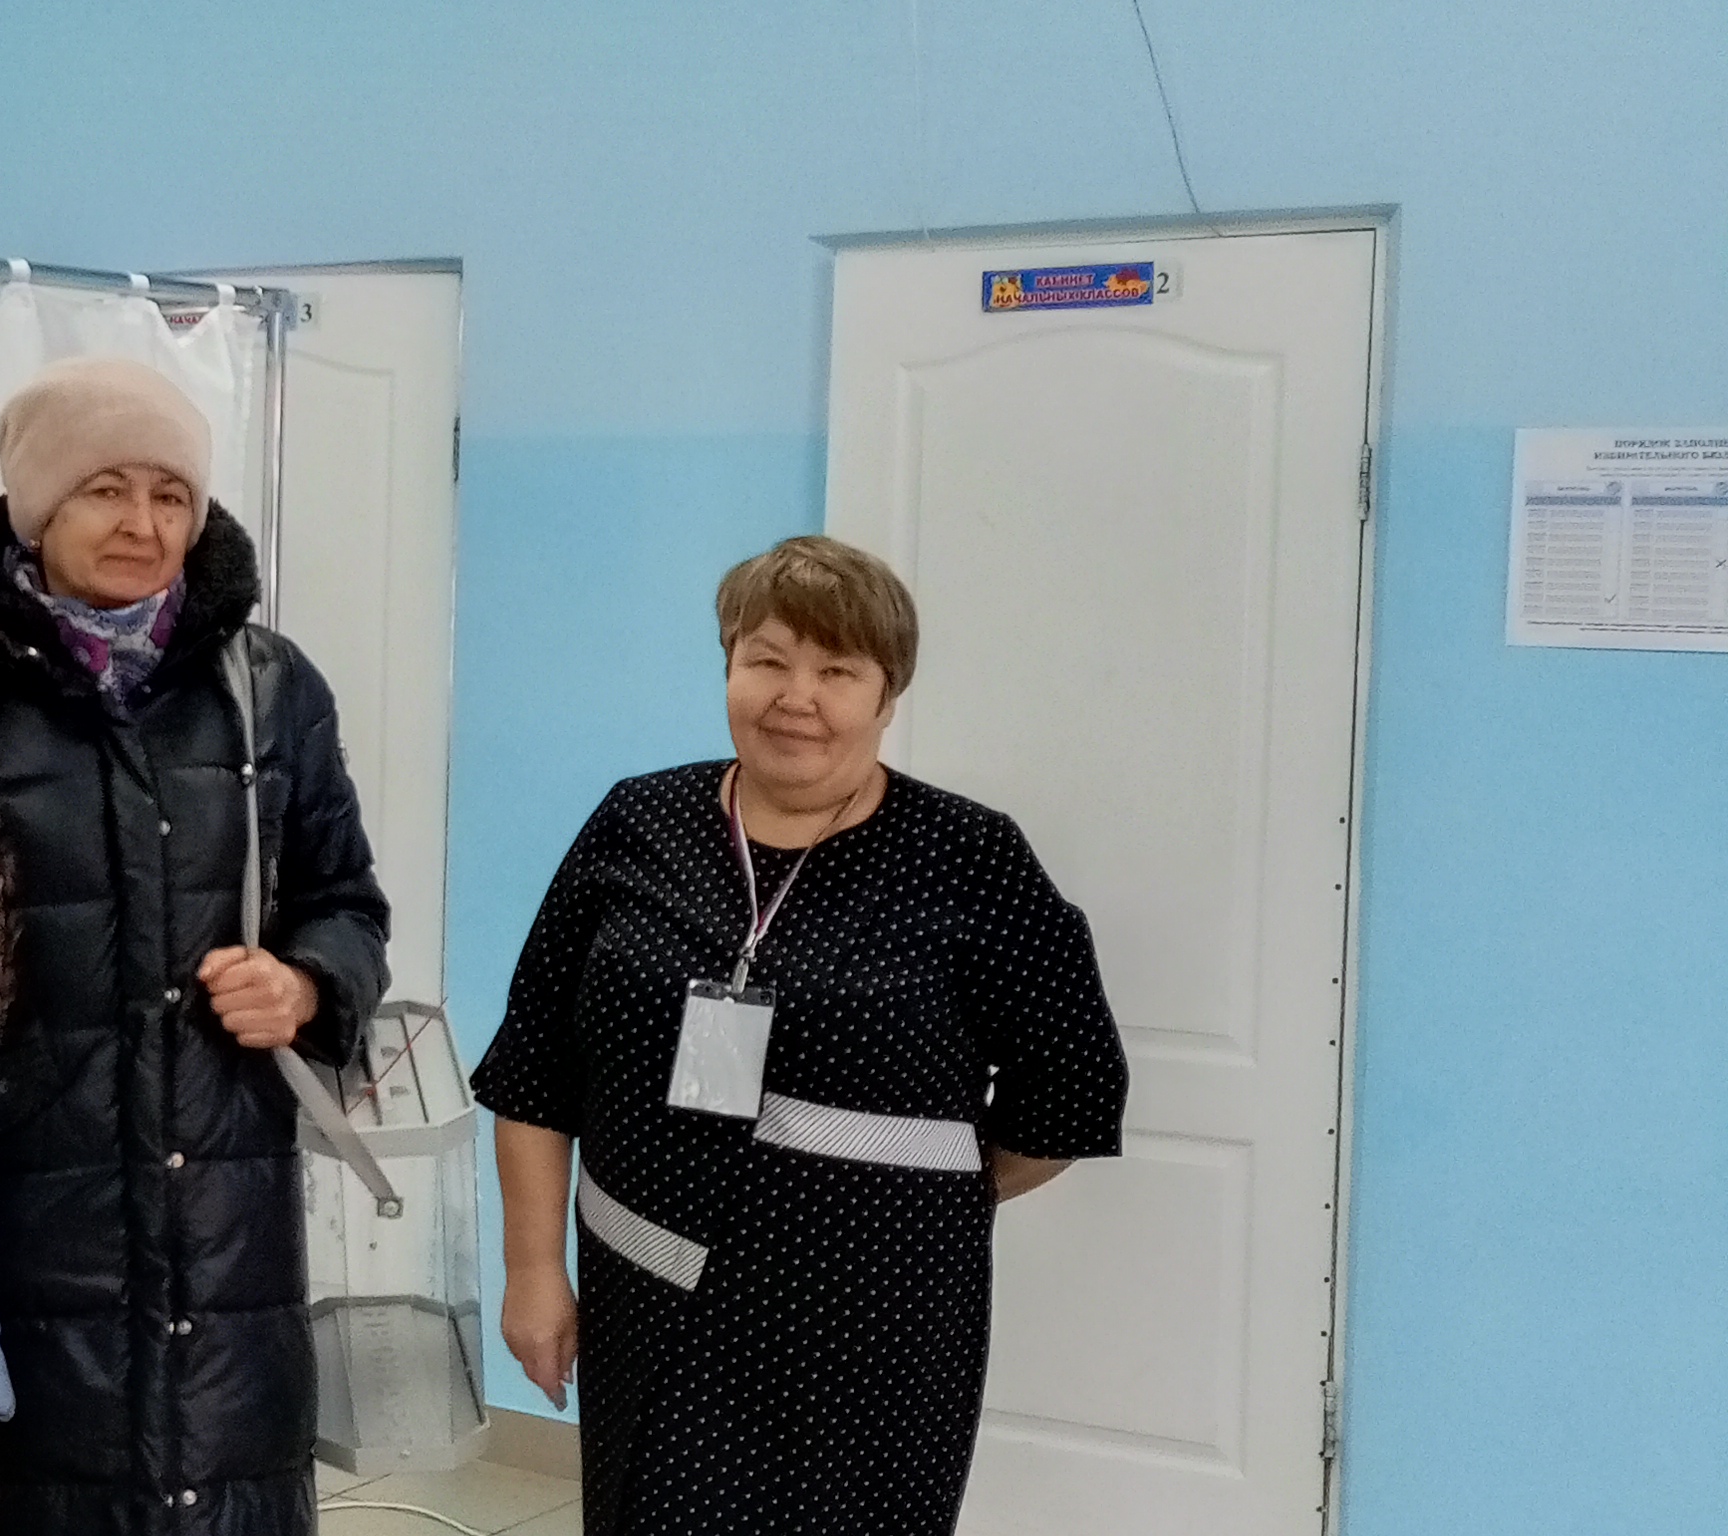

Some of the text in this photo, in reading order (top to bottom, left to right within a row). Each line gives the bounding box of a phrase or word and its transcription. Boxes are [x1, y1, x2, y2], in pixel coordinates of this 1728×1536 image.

[1035, 274, 1094, 287] КАБИНЕТ
[1156, 272, 1170, 295] 2
[993, 287, 1139, 304] НАЧАЛЬНЫХ КЛАССОВ
[300, 303, 312, 323] 3
